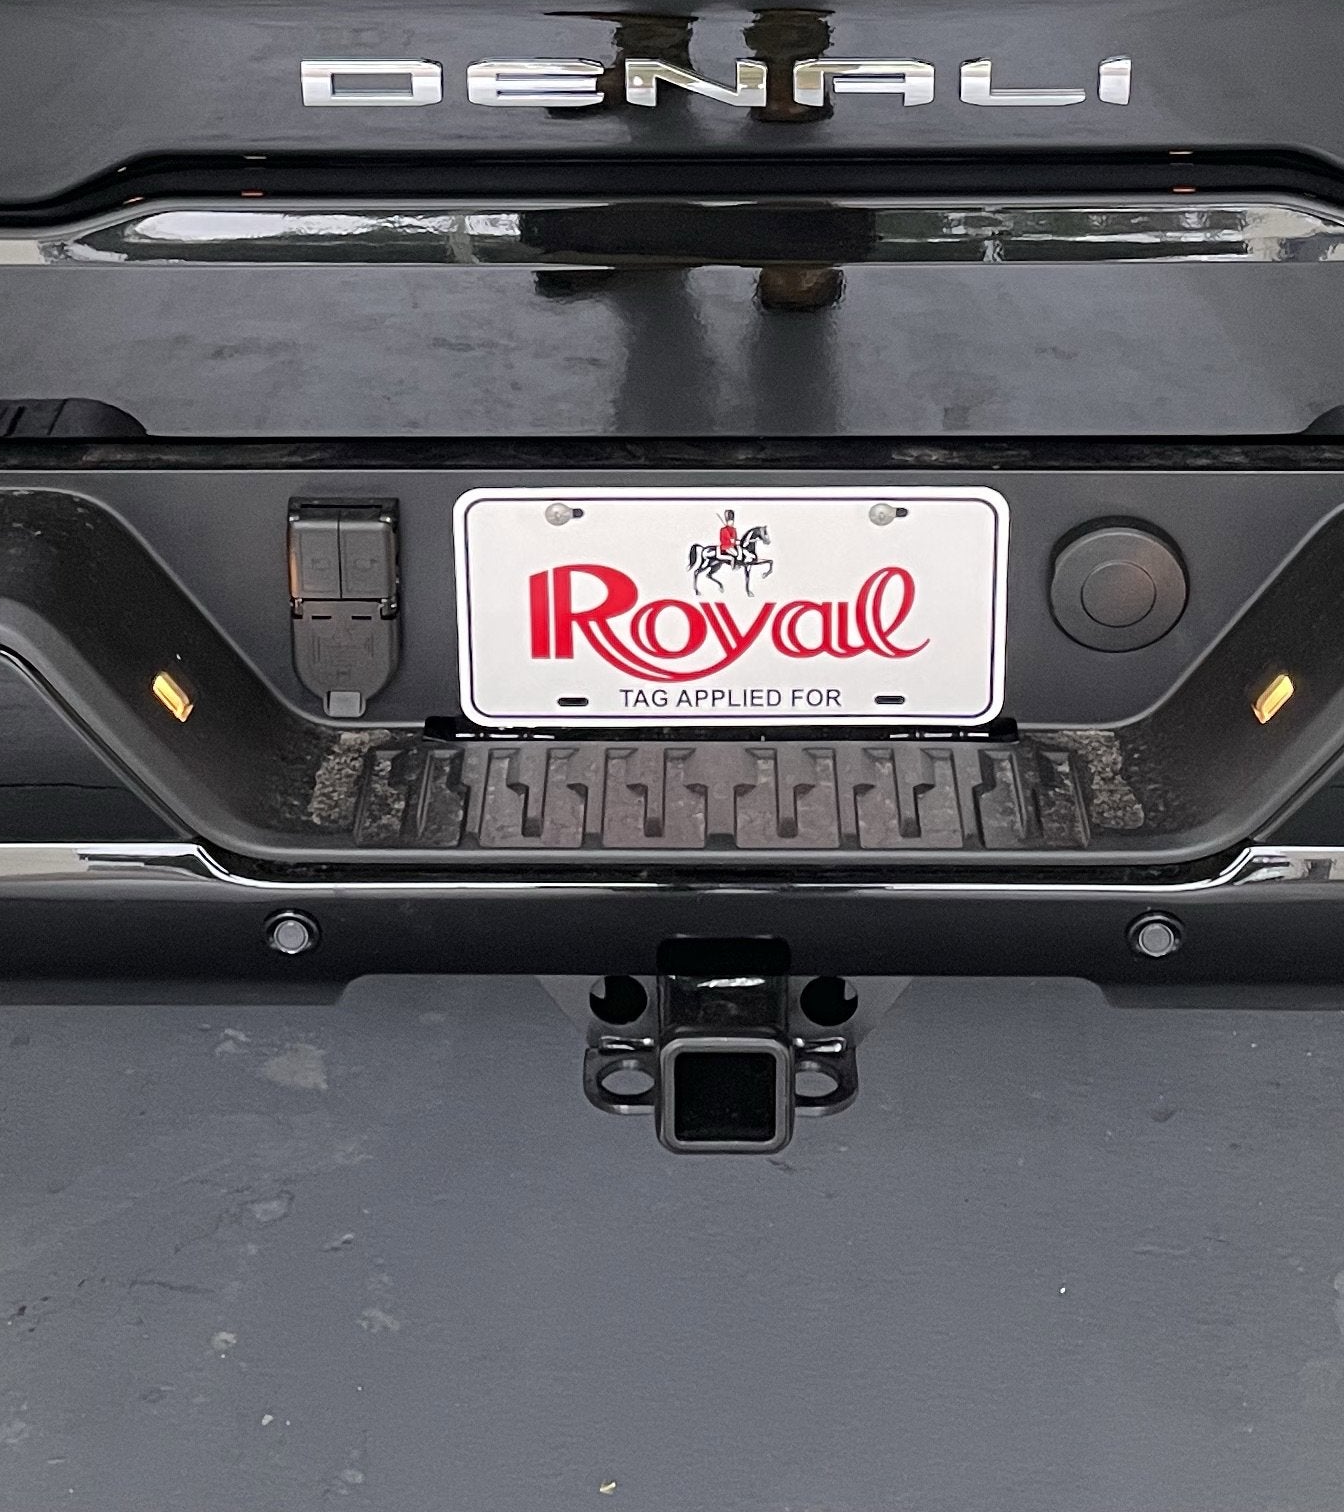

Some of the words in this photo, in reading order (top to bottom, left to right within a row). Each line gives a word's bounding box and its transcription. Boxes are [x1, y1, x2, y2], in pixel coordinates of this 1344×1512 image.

[300, 56, 1134, 108] DENALI
[528, 564, 931, 682] Royal
[619, 688, 669, 708] TAG
[676, 688, 782, 708] APPLIED
[790, 688, 842, 708] FOR
